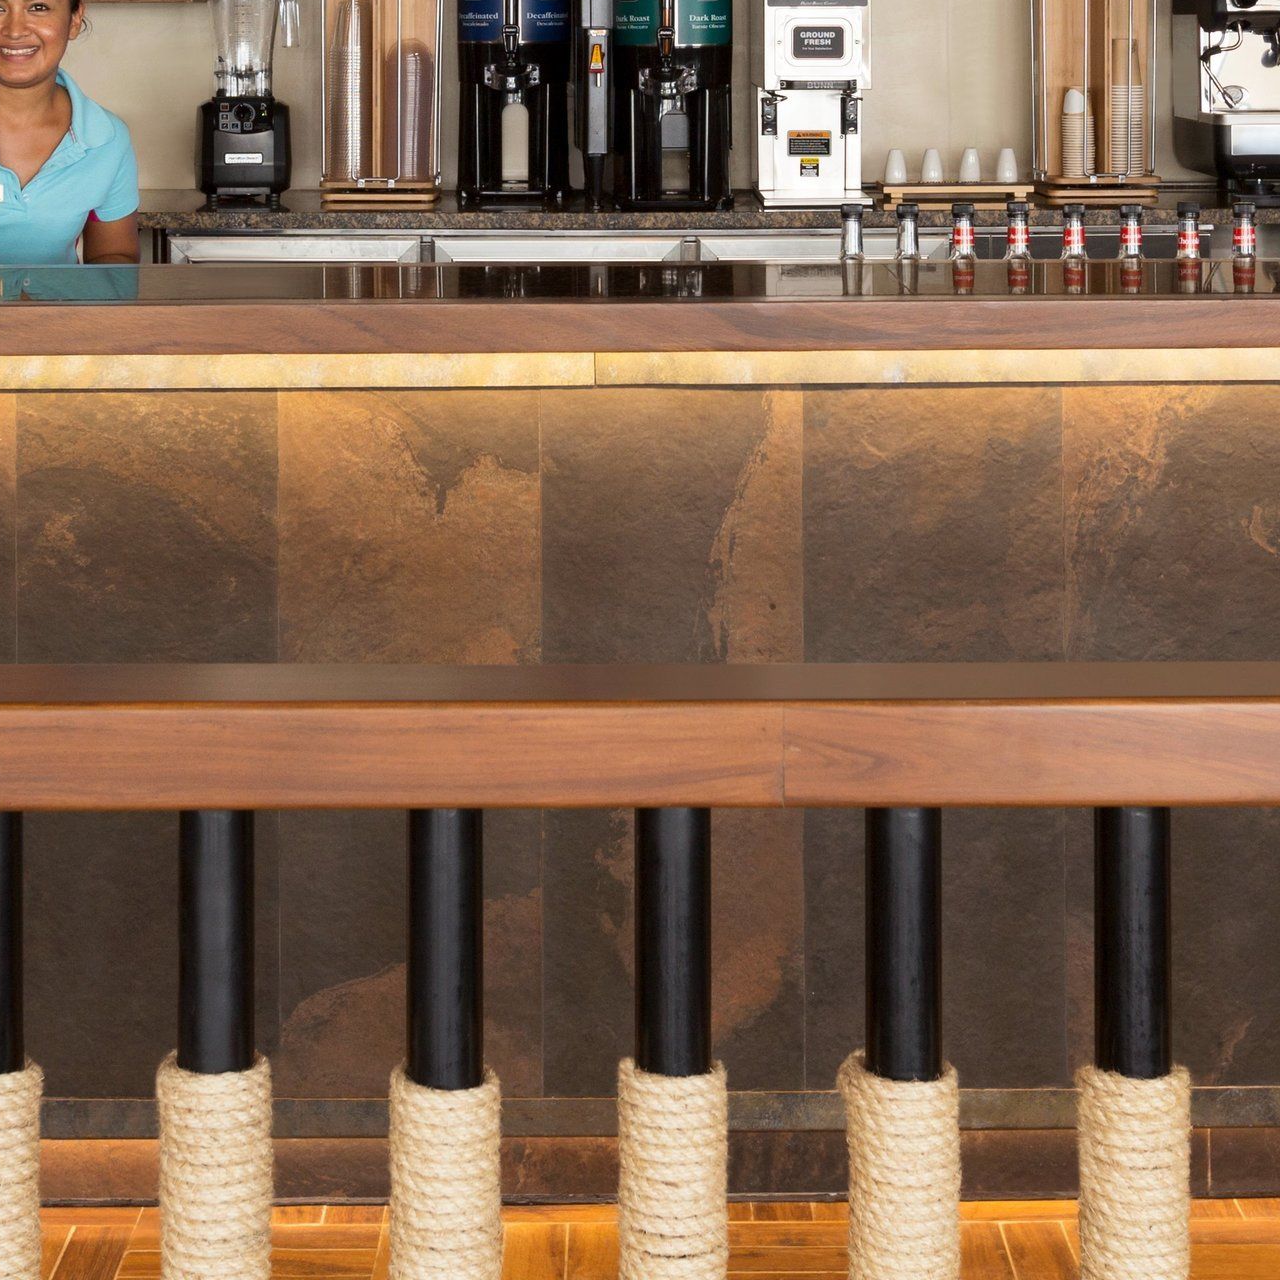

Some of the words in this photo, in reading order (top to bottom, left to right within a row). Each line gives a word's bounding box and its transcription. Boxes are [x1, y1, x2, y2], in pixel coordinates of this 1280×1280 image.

[689, 14, 709, 22] Dark
[800, 31, 835, 39] GROUND
[806, 81, 833, 89] BUNN
